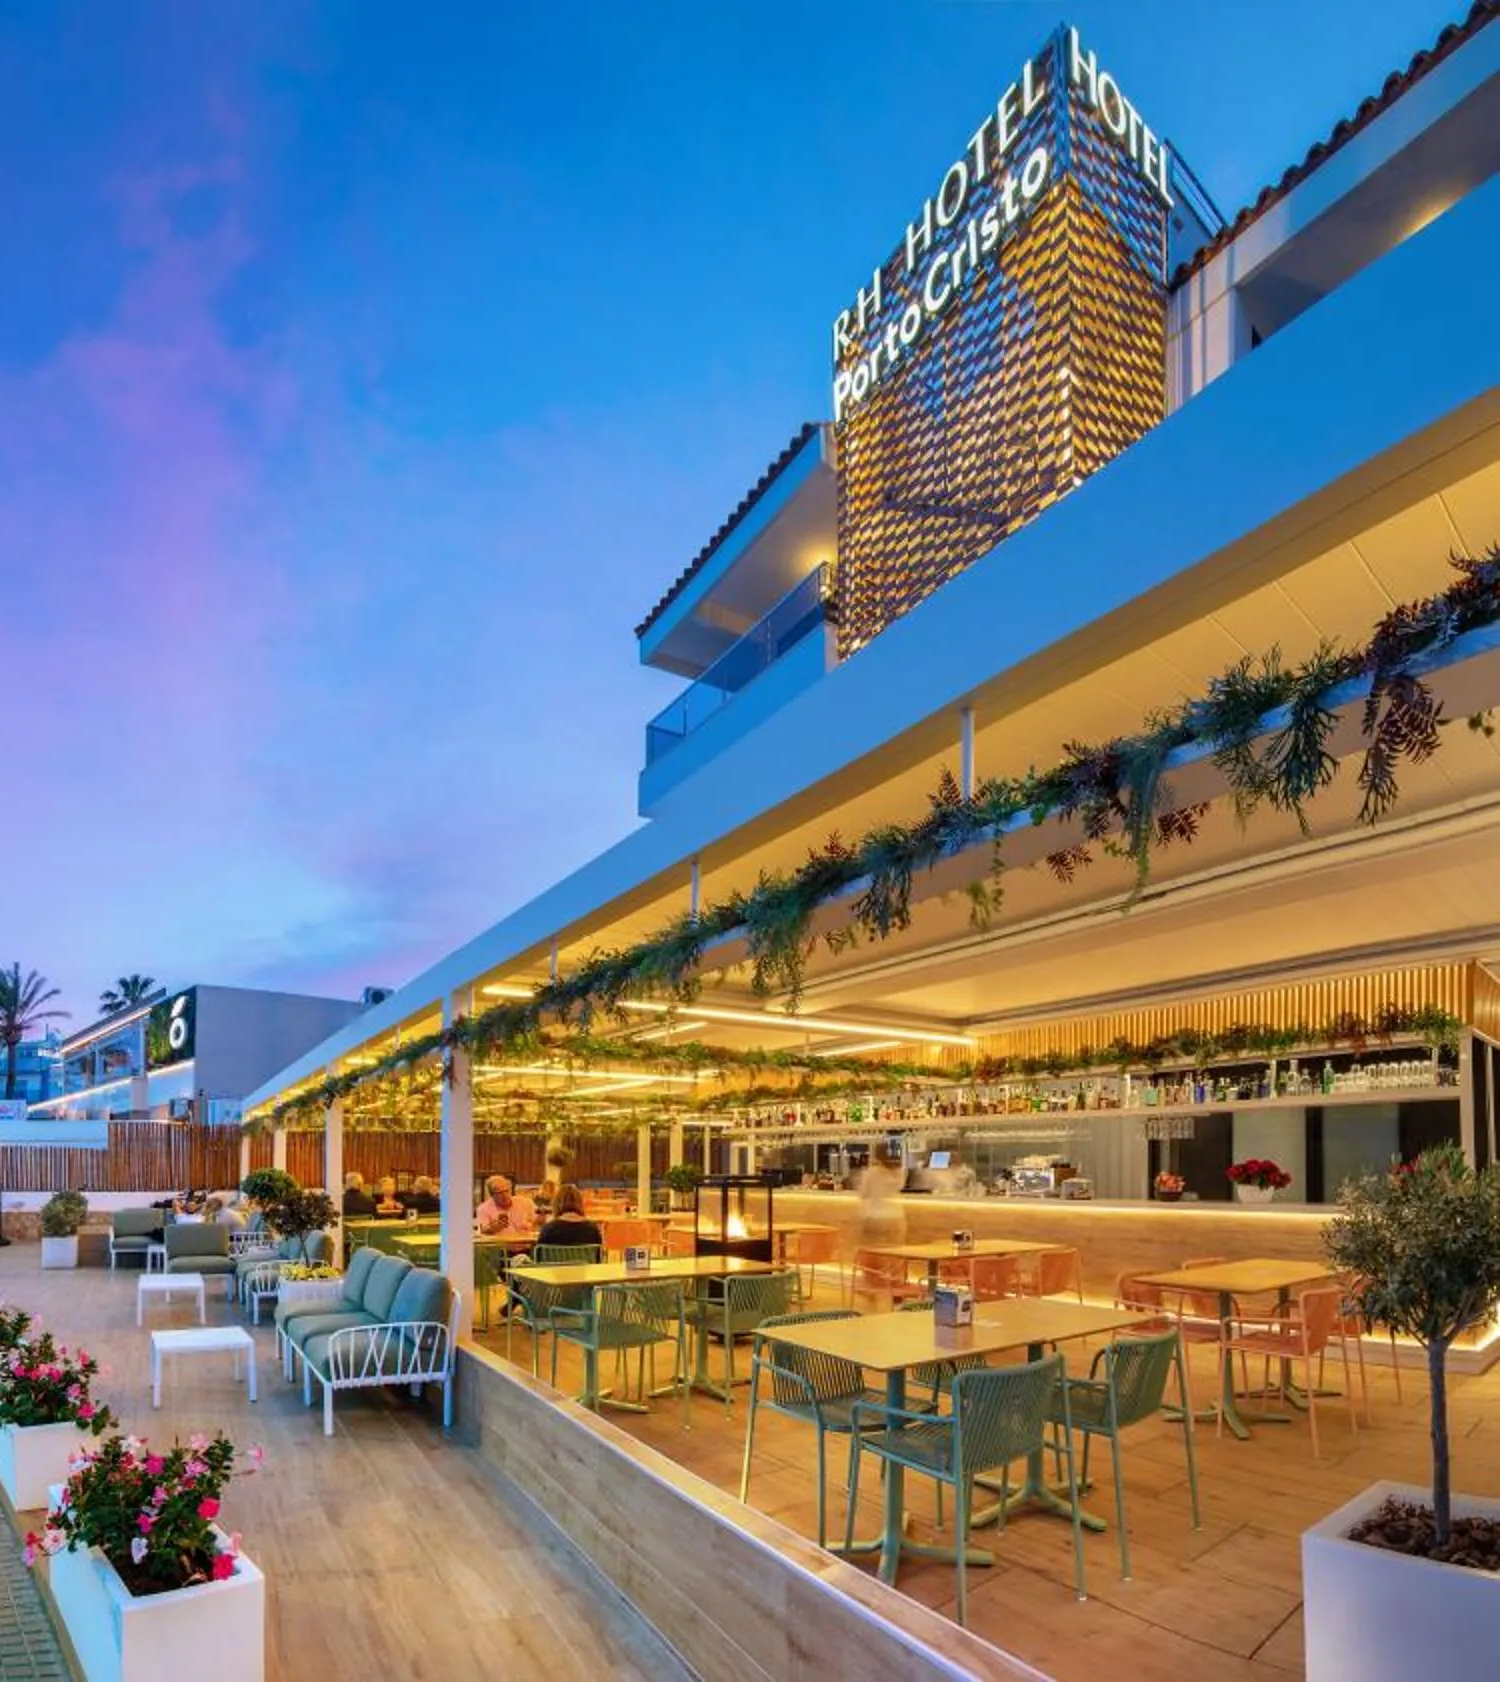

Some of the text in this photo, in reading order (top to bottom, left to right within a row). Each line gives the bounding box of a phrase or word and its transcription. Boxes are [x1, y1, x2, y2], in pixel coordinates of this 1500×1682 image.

[833, 58, 1046, 362] RH HOTEL
[1070, 25, 1175, 208] HOTEL
